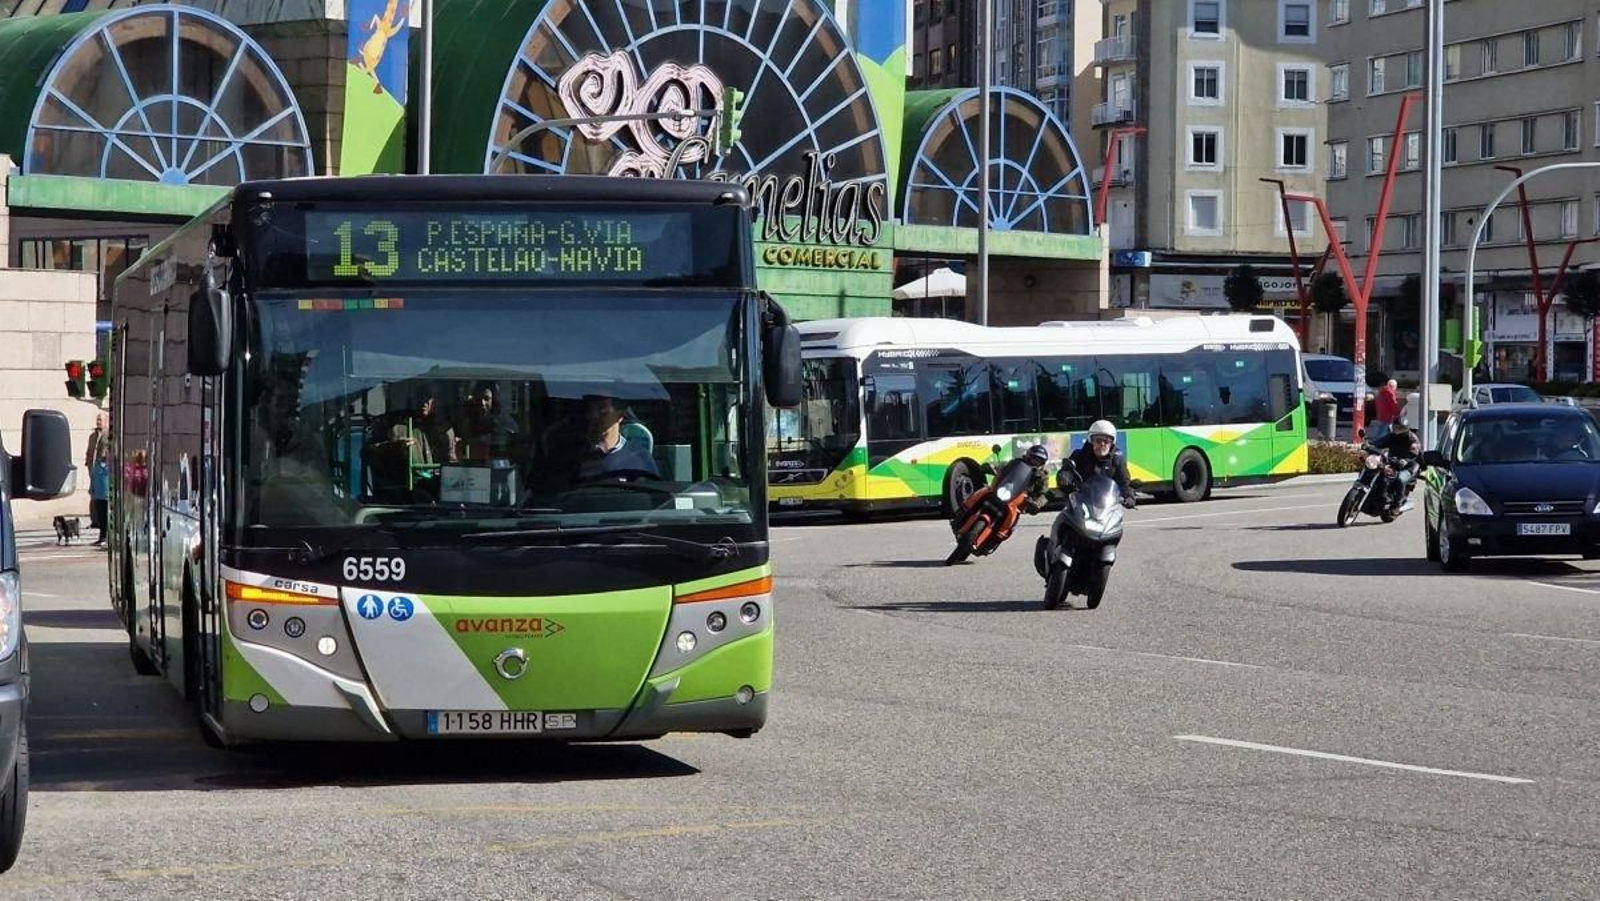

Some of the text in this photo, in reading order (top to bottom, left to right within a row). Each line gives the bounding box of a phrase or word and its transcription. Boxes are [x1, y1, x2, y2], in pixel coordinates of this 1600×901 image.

[427, 221, 631, 245] P.ESPAÑA-G.VIA
[333, 221, 398, 276] 13
[763, 247, 882, 269] COMERCIAL
[418, 248, 642, 272] CASTELAO-NAVIA
[1548, 524, 1567, 533] FPV
[343, 557, 405, 581] 6559
[274, 577, 319, 594] carsa
[456, 618, 542, 632] avanza
[443, 712, 537, 730] 1158 HHR
[548, 715, 573, 727] SP
